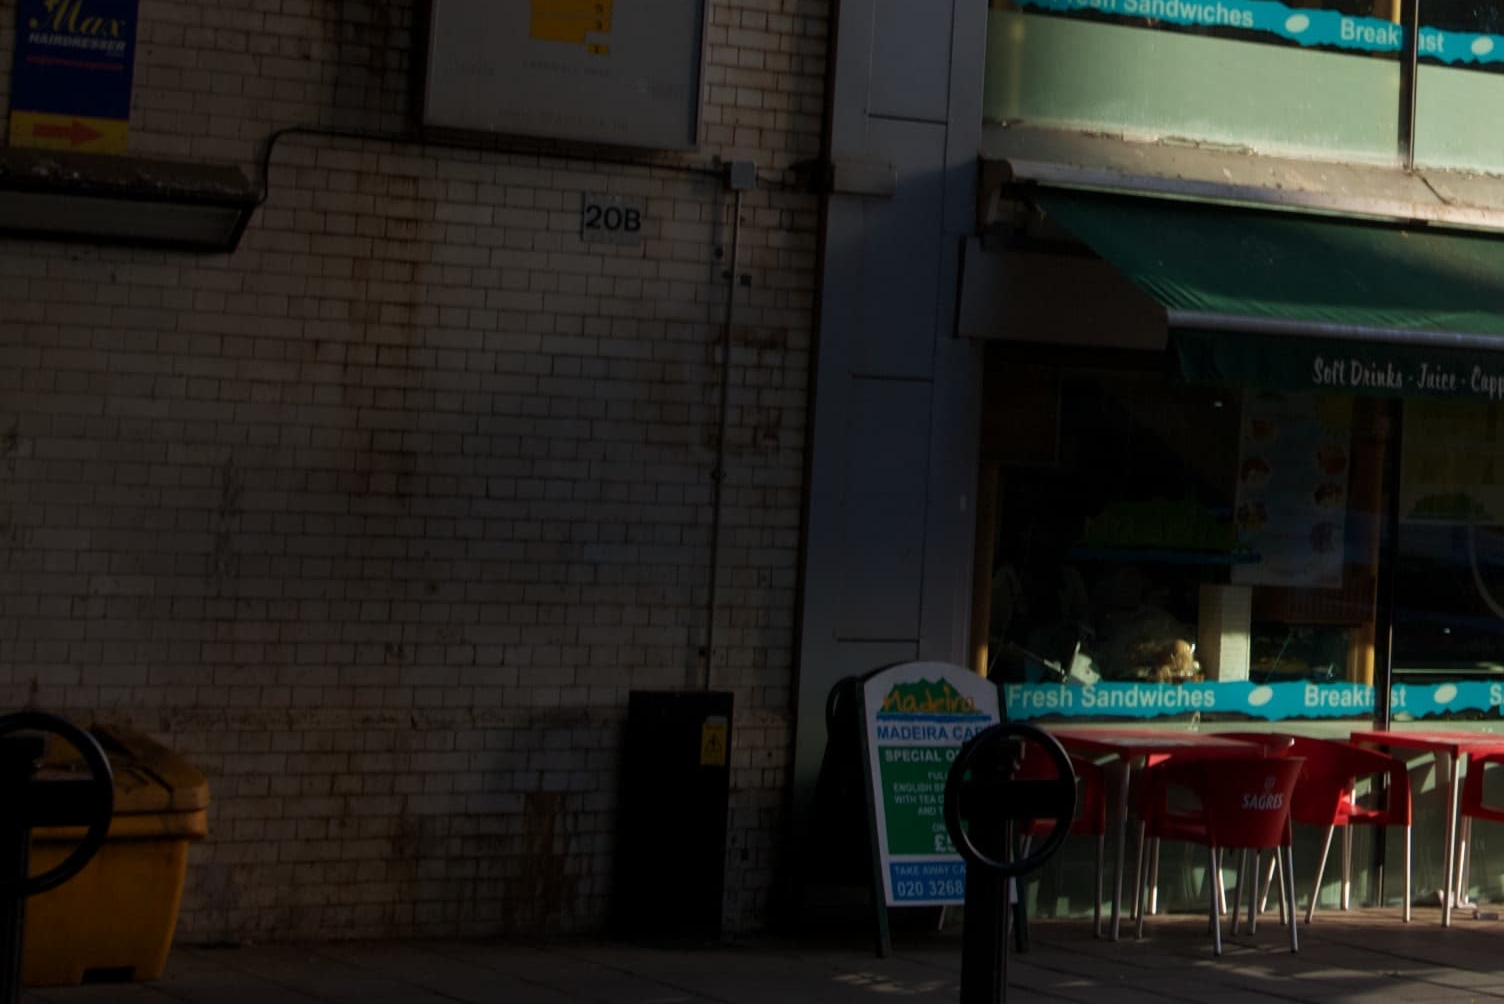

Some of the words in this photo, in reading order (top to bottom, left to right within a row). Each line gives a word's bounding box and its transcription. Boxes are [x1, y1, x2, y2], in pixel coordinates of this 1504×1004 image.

[1340, 20, 1445, 53] Breakst
[585, 204, 640, 232] 20B
[1311, 356, 1347, 386] Soft
[1350, 359, 1403, 389] Drinks
[1417, 362, 1456, 391] Juice
[1007, 683, 1072, 710] Fresh
[1080, 682, 1216, 710] Sandwiches
[1304, 683, 1407, 708] Breakfst
[877, 724, 949, 741] MADEIRA
[953, 725, 988, 741] CAF
[885, 747, 942, 763] SPECIAL
[893, 781, 932, 794] ENGLISH
[893, 793, 917, 805] WITH
[1241, 792, 1284, 810] SAGRES
[917, 805, 936, 817] AND
[896, 879, 923, 898] 020
[928, 879, 965, 897] 3268
